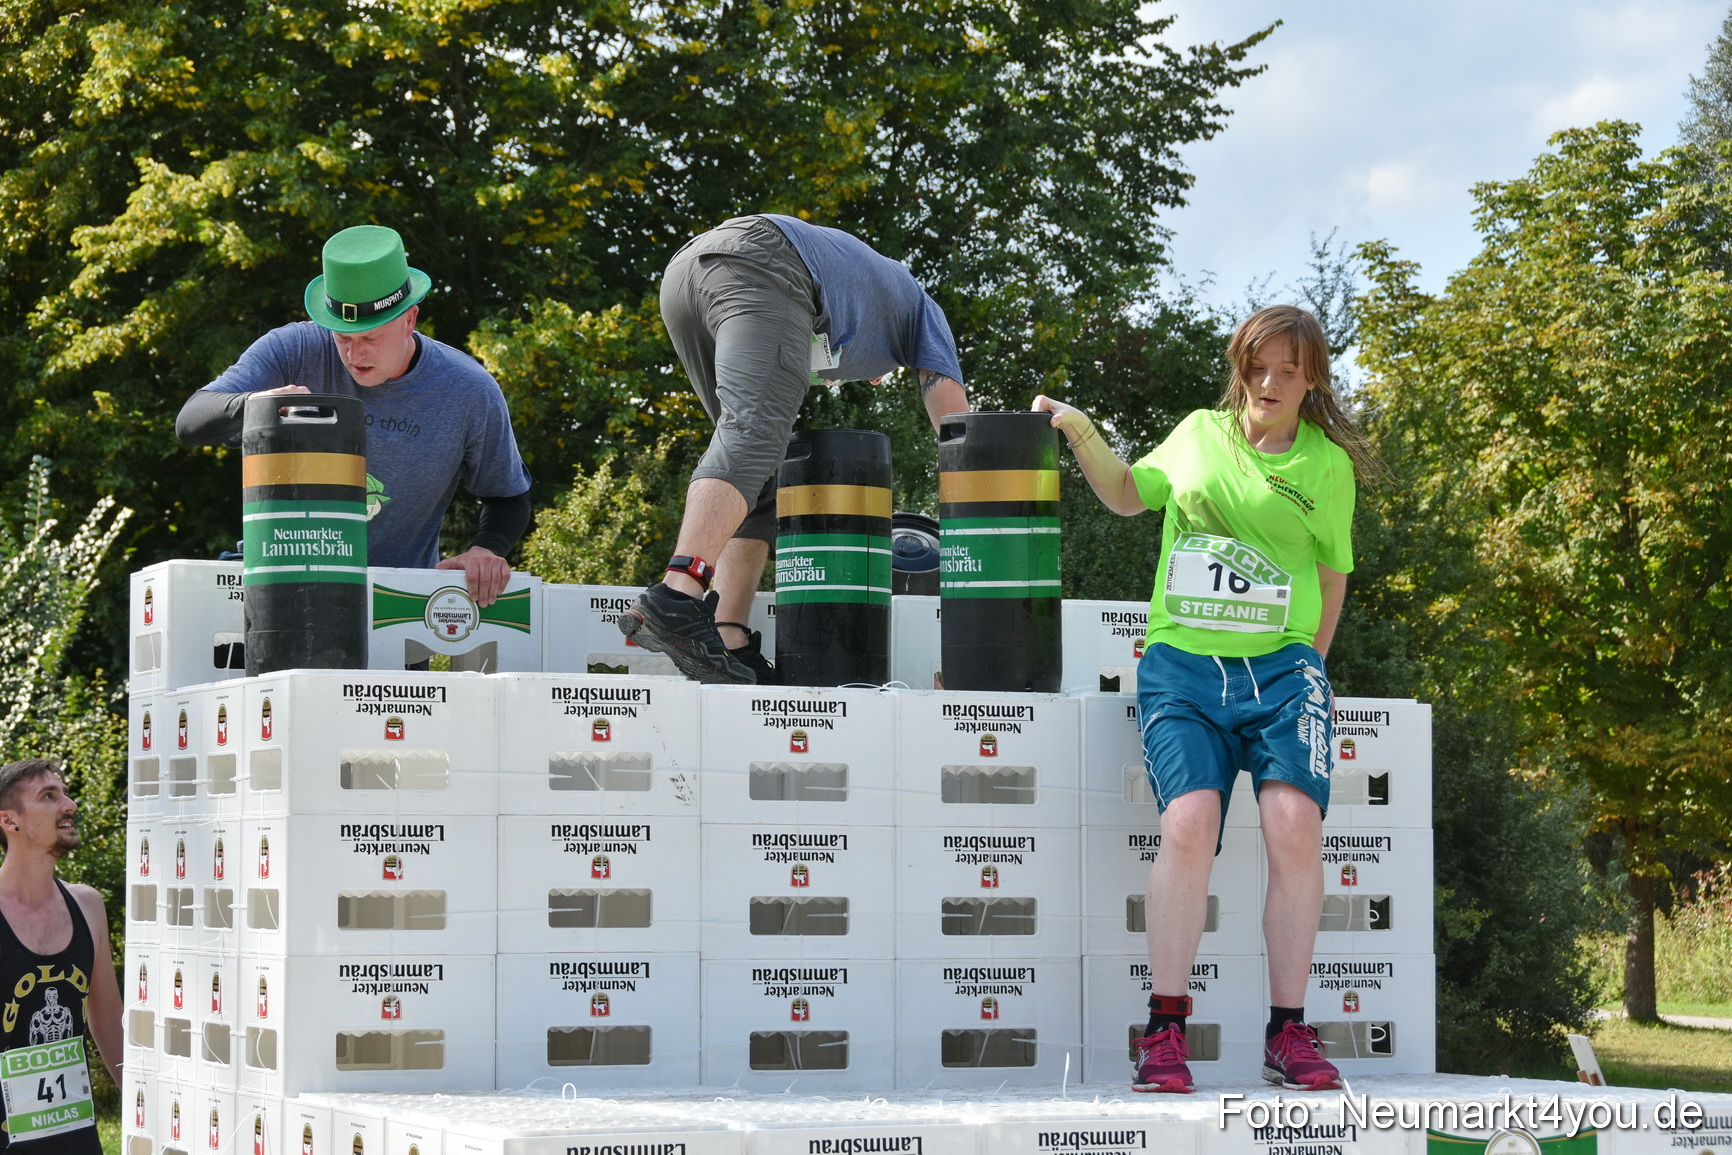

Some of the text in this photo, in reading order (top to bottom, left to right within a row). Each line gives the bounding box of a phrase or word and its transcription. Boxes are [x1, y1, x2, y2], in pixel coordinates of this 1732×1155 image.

[380, 417, 421, 437] thóin
[273, 527, 343, 540] Neumarkter
[262, 539, 353, 557] Lammsbräu
[1183, 535, 1280, 586] BOCK
[1208, 562, 1251, 594] 16
[1179, 600, 1269, 621] STEFANIE
[343, 685, 446, 702] Lammsbräu
[552, 687, 650, 705] Lammsbräu
[356, 703, 432, 716] Neumarkter
[564, 706, 636, 718] Neumarkter
[752, 699, 846, 717] Lammsbräu
[943, 704, 1034, 721] Lammsbräu
[764, 718, 833, 728] Neumarkter
[954, 722, 1021, 734] Neumarkter
[341, 825, 444, 841] Lammsbräu
[551, 825, 650, 841] Lammsbräu
[354, 843, 430, 855] Neumarkter
[564, 843, 636, 855] Neumarkter
[753, 834, 847, 850] Lammsbräu
[944, 836, 1035, 852] Lammsbräu
[1321, 836, 1391, 851] Lammsbr
[764, 852, 834, 863] Neumarkter
[955, 854, 1022, 865] Neumarkter
[1322, 853, 1379, 864] Neumarkte
[340, 964, 443, 981] Lammsbräu
[550, 962, 649, 979] Lammsbräu
[753, 968, 847, 984] Lammsbräu
[944, 968, 1035, 983] Lammsbräu
[352, 983, 428, 995] Neumarkter
[562, 981, 635, 993] Neumarkter
[764, 986, 834, 998] Neumarkter
[955, 985, 1022, 997] Neumarkter
[1319, 980, 1381, 991] Neumarkter
[7, 1041, 80, 1074] BOCK
[37, 1073, 67, 1103] 41
[31, 1107, 80, 1128] NIKLAS
[1039, 1131, 1146, 1150] Lammsbräu
[1671, 1136, 1732, 1149] eumarkter
